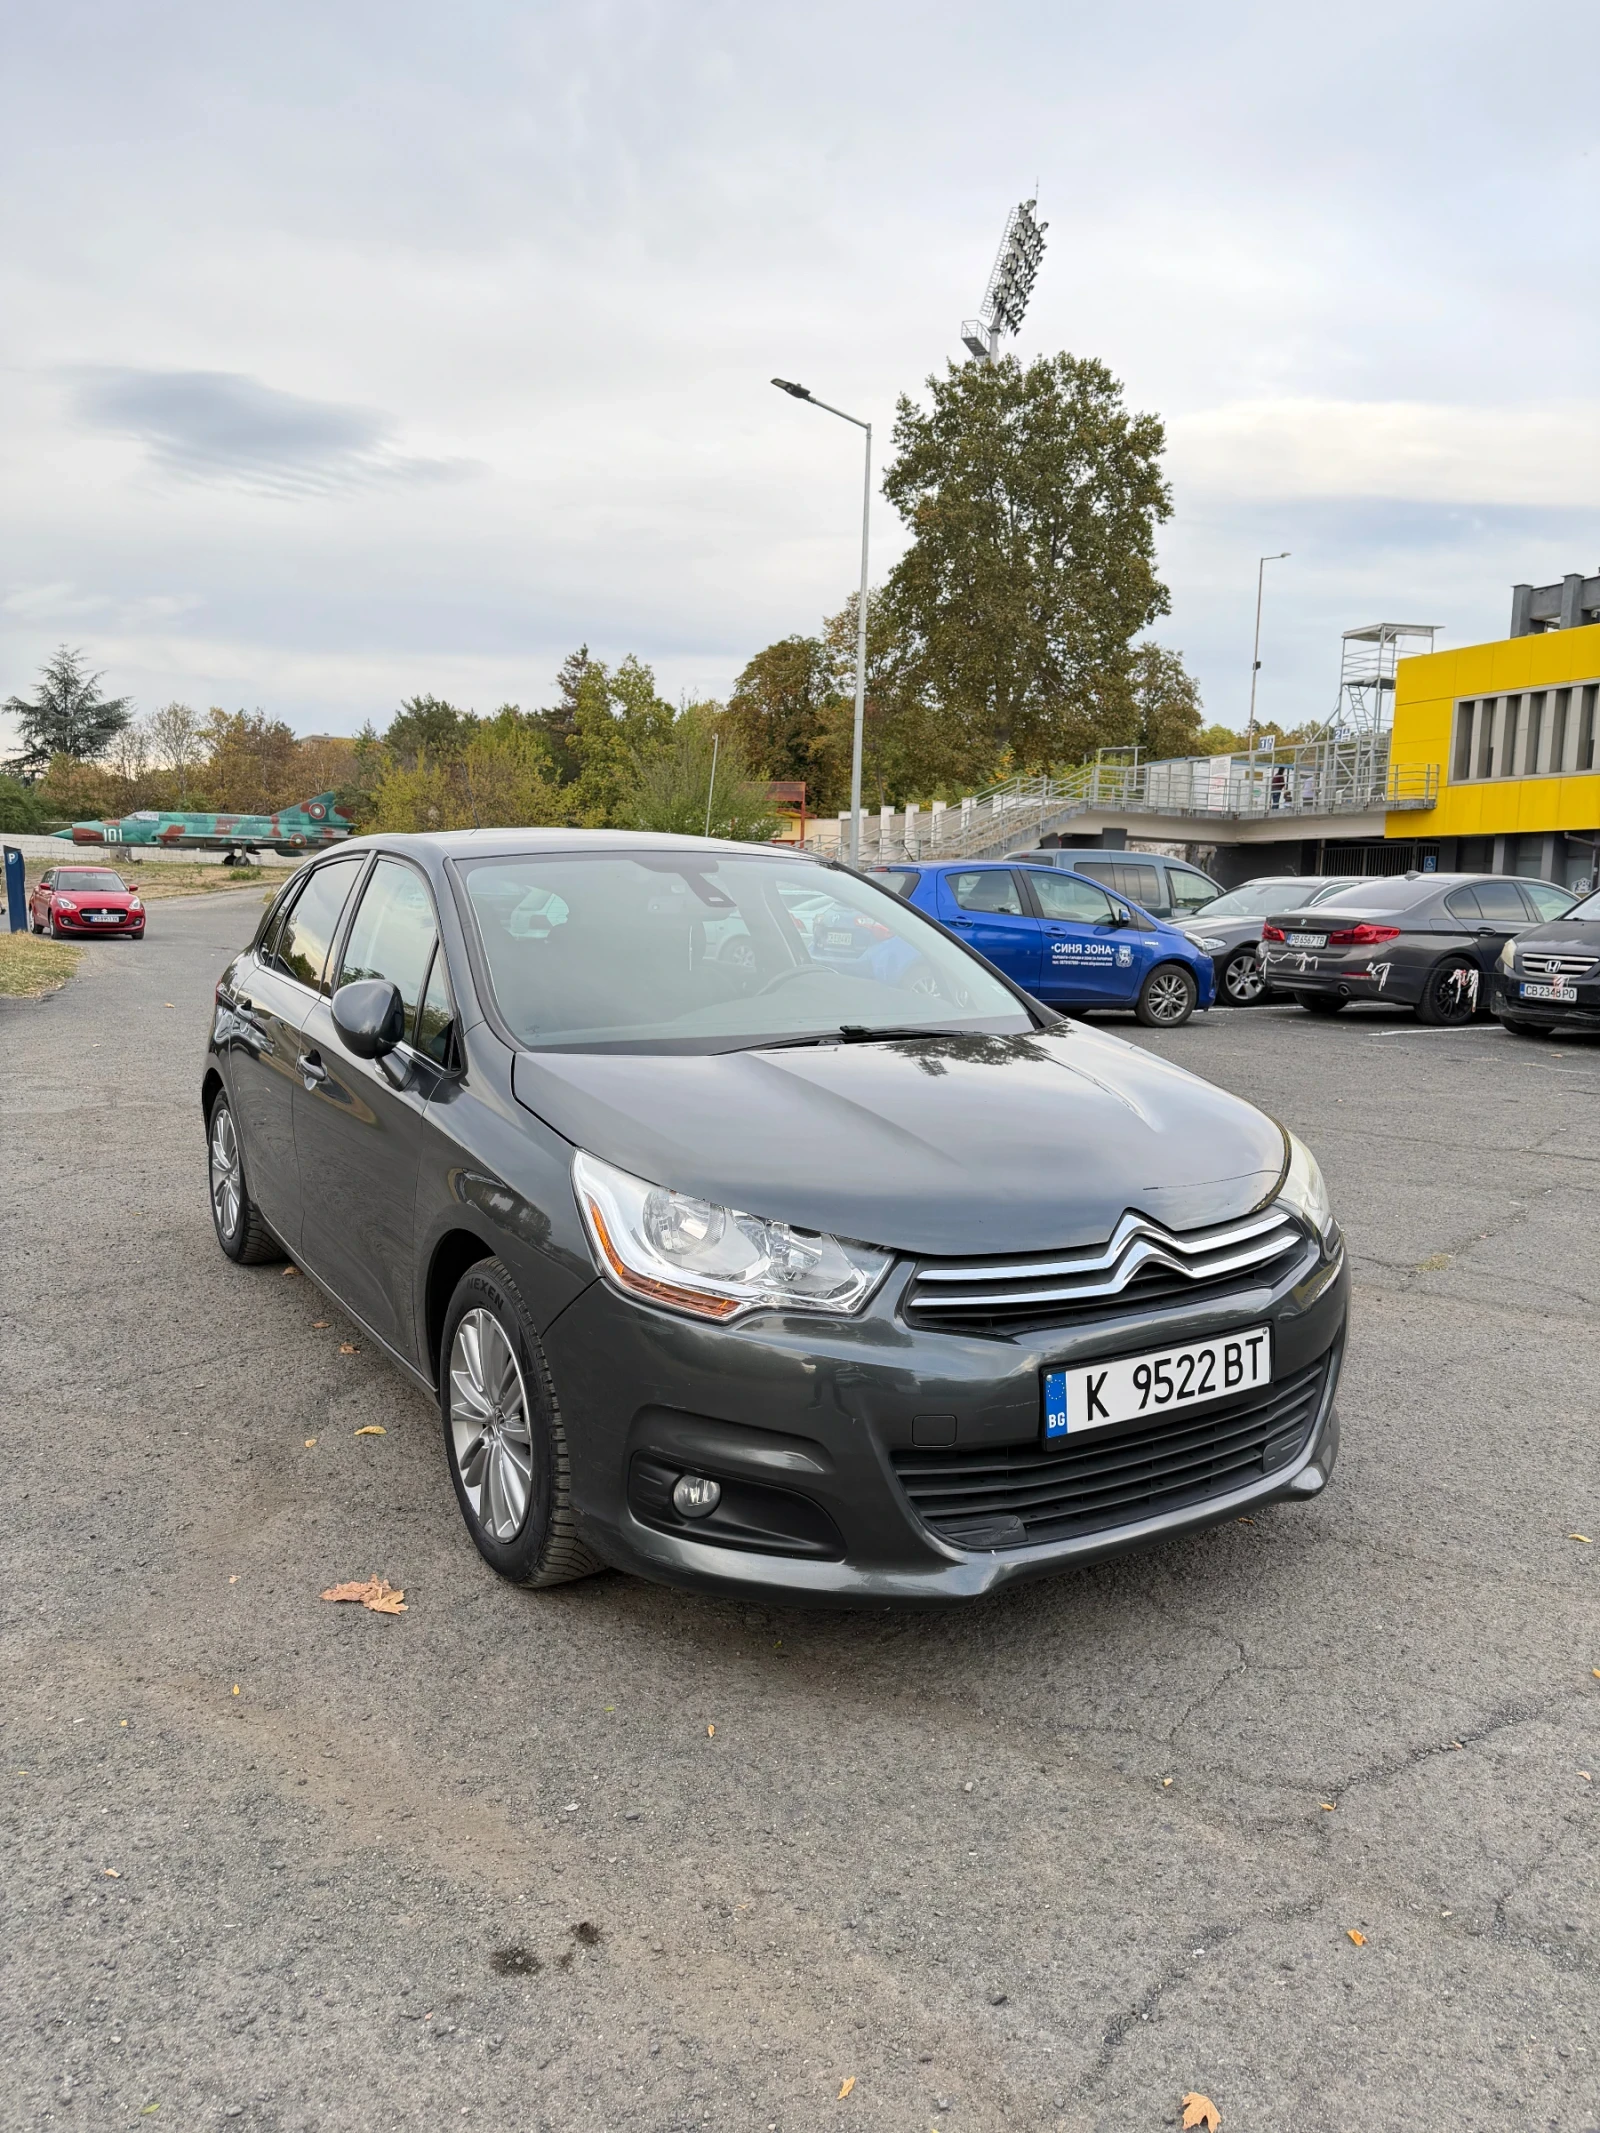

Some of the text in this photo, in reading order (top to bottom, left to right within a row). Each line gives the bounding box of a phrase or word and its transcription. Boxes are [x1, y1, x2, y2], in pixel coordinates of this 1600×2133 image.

[104, 828, 122, 842] 101
[8, 853, 15, 862] P
[1054, 943, 1112, 954] СИНЯ ЗОНА
[466, 1277, 504, 1311] NEXEN
[1086, 1371, 1110, 1422] K
[1048, 1412, 1066, 1429] BG
